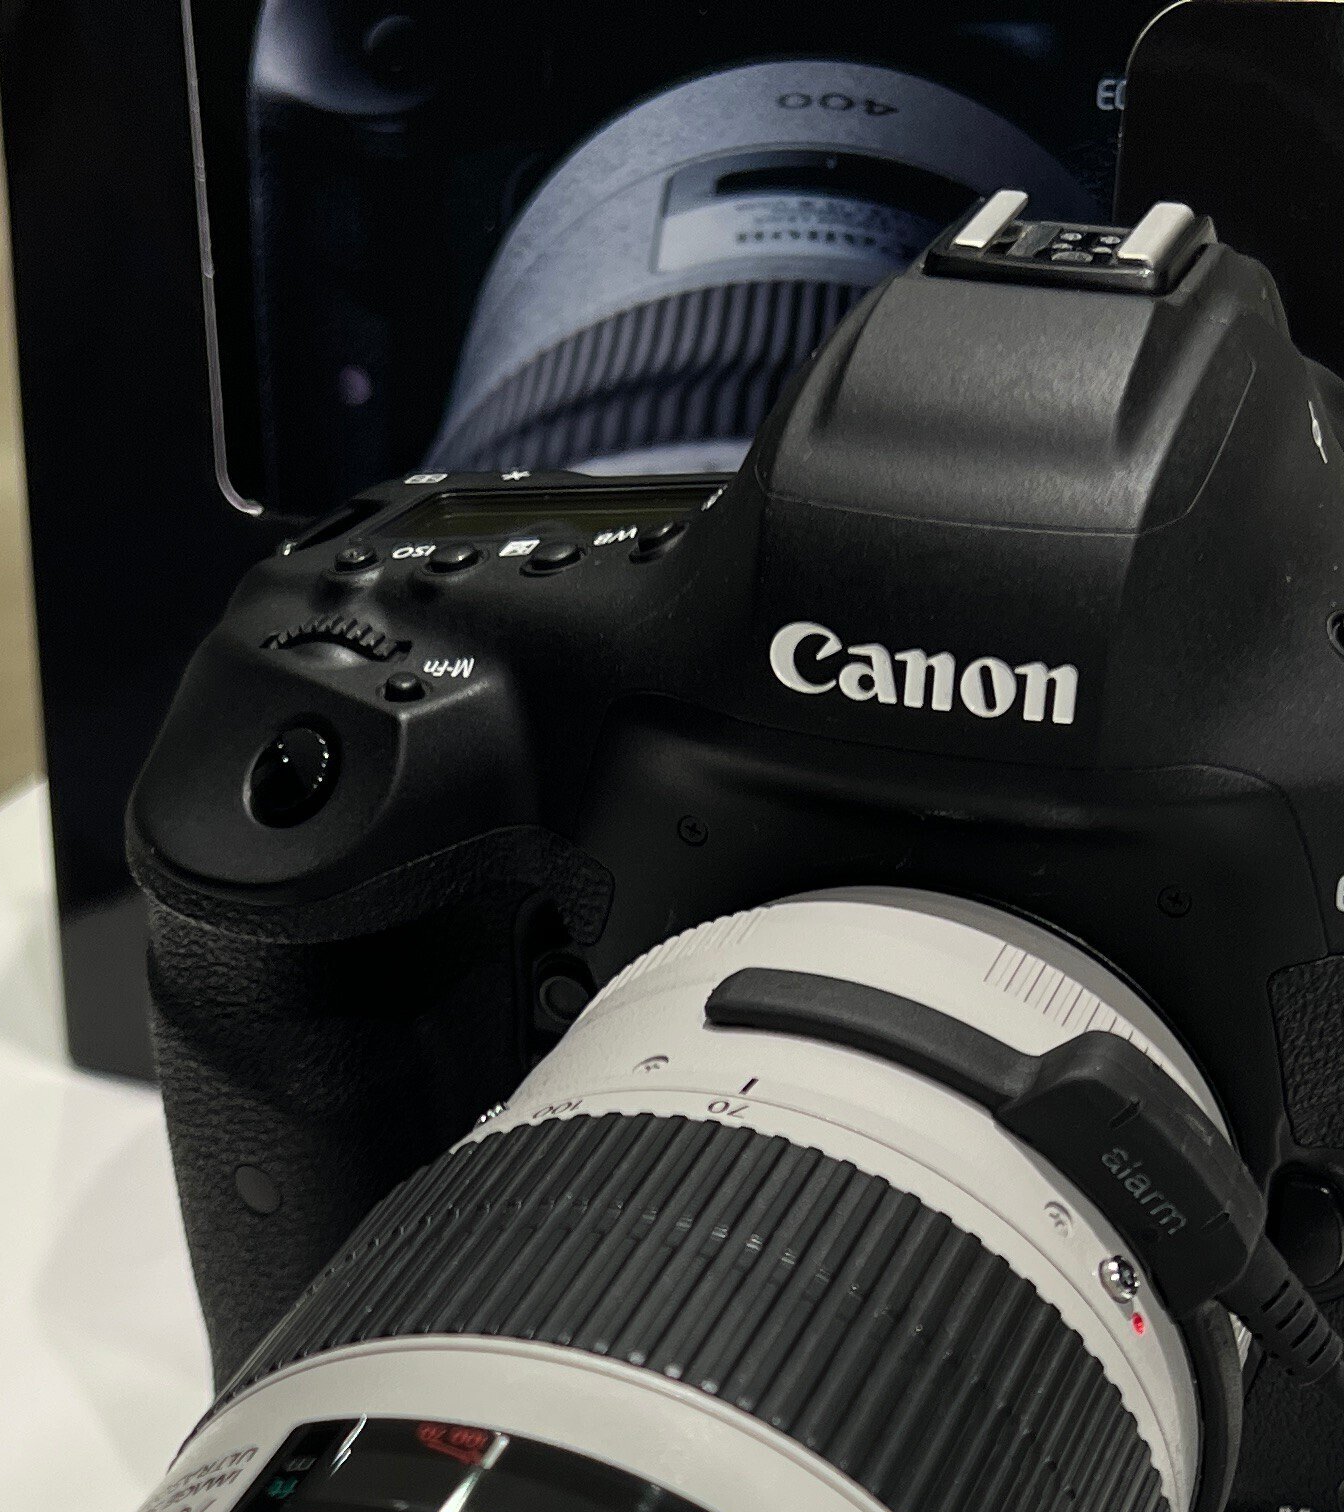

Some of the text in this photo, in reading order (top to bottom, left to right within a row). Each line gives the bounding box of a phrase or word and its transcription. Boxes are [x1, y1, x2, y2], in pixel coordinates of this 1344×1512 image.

[777, 90, 900, 119] 400
[392, 544, 436, 559] ISO
[422, 658, 475, 680] M-Fn
[769, 620, 1079, 726] Canon
[531, 1099, 583, 1119] 100
[707, 1099, 751, 1119] 70
